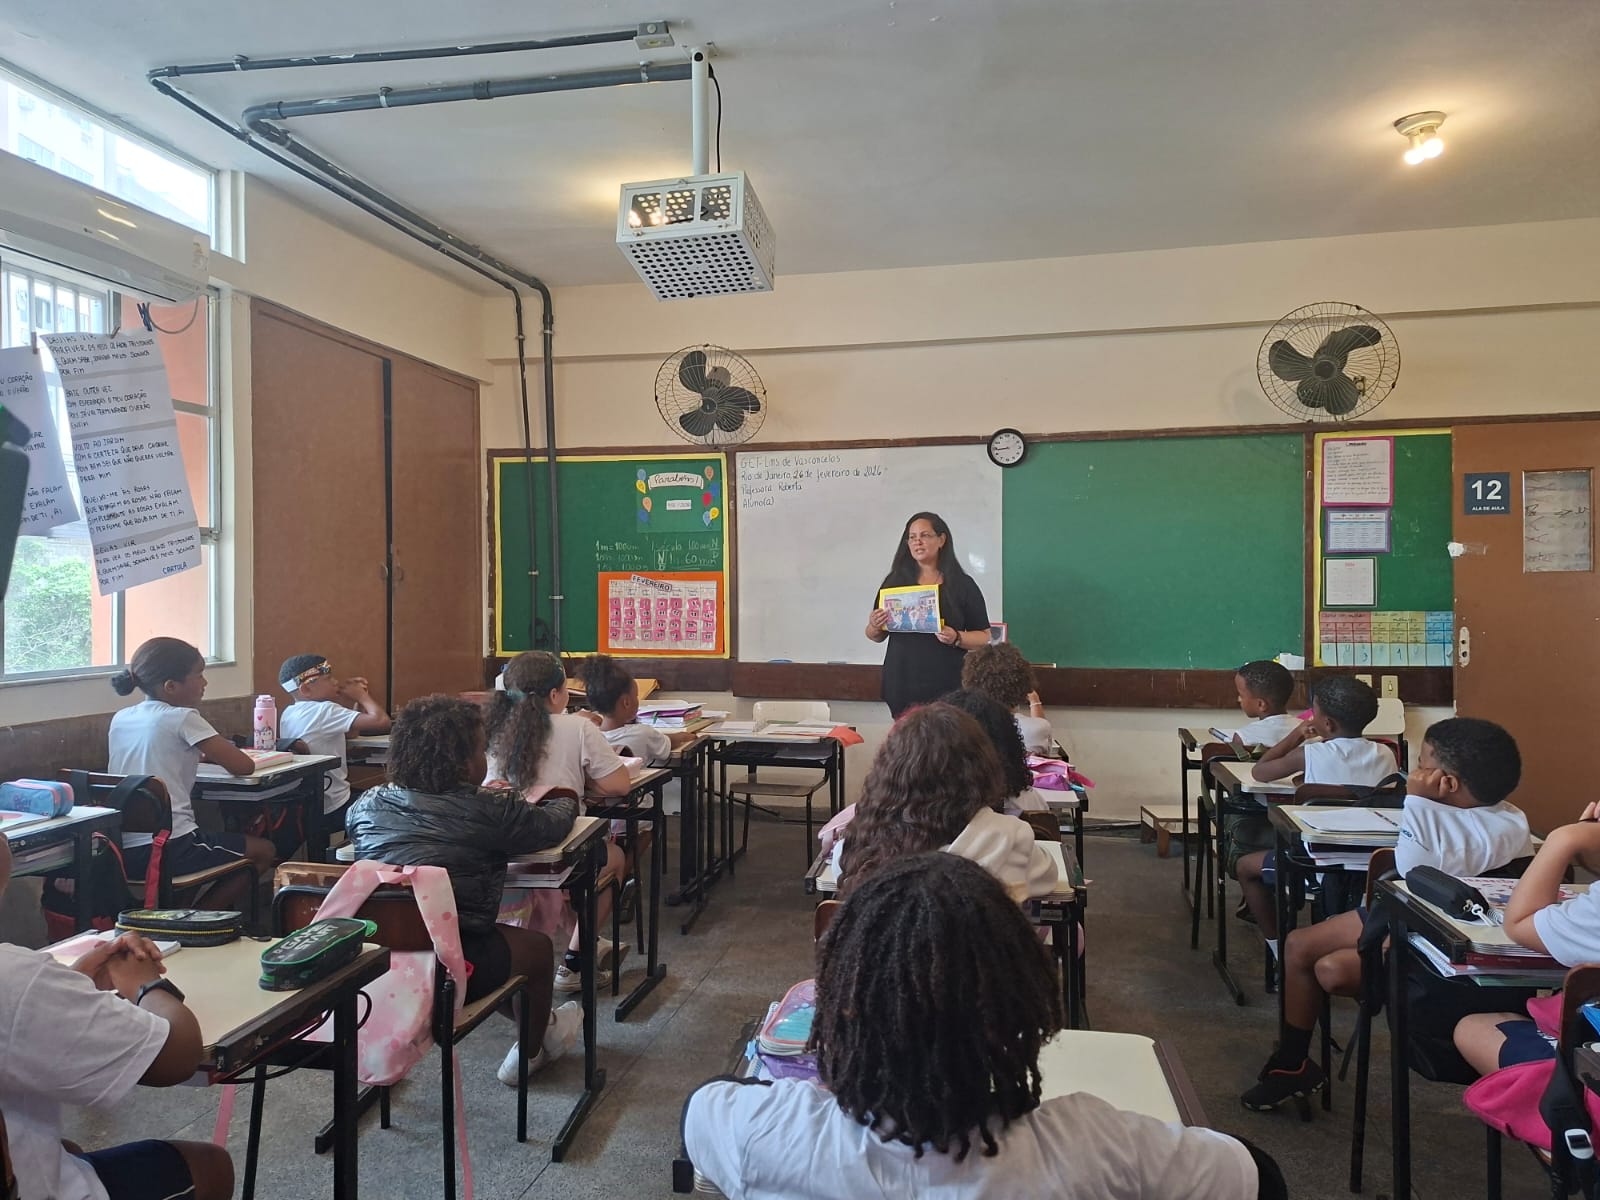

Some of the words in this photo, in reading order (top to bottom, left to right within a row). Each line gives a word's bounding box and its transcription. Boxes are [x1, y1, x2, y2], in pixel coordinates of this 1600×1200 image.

[1471, 479, 1502, 500] 12
[632, 575, 671, 591] FEVEREIRO
[280, 922, 328, 950] GAME
[293, 924, 340, 951] START
